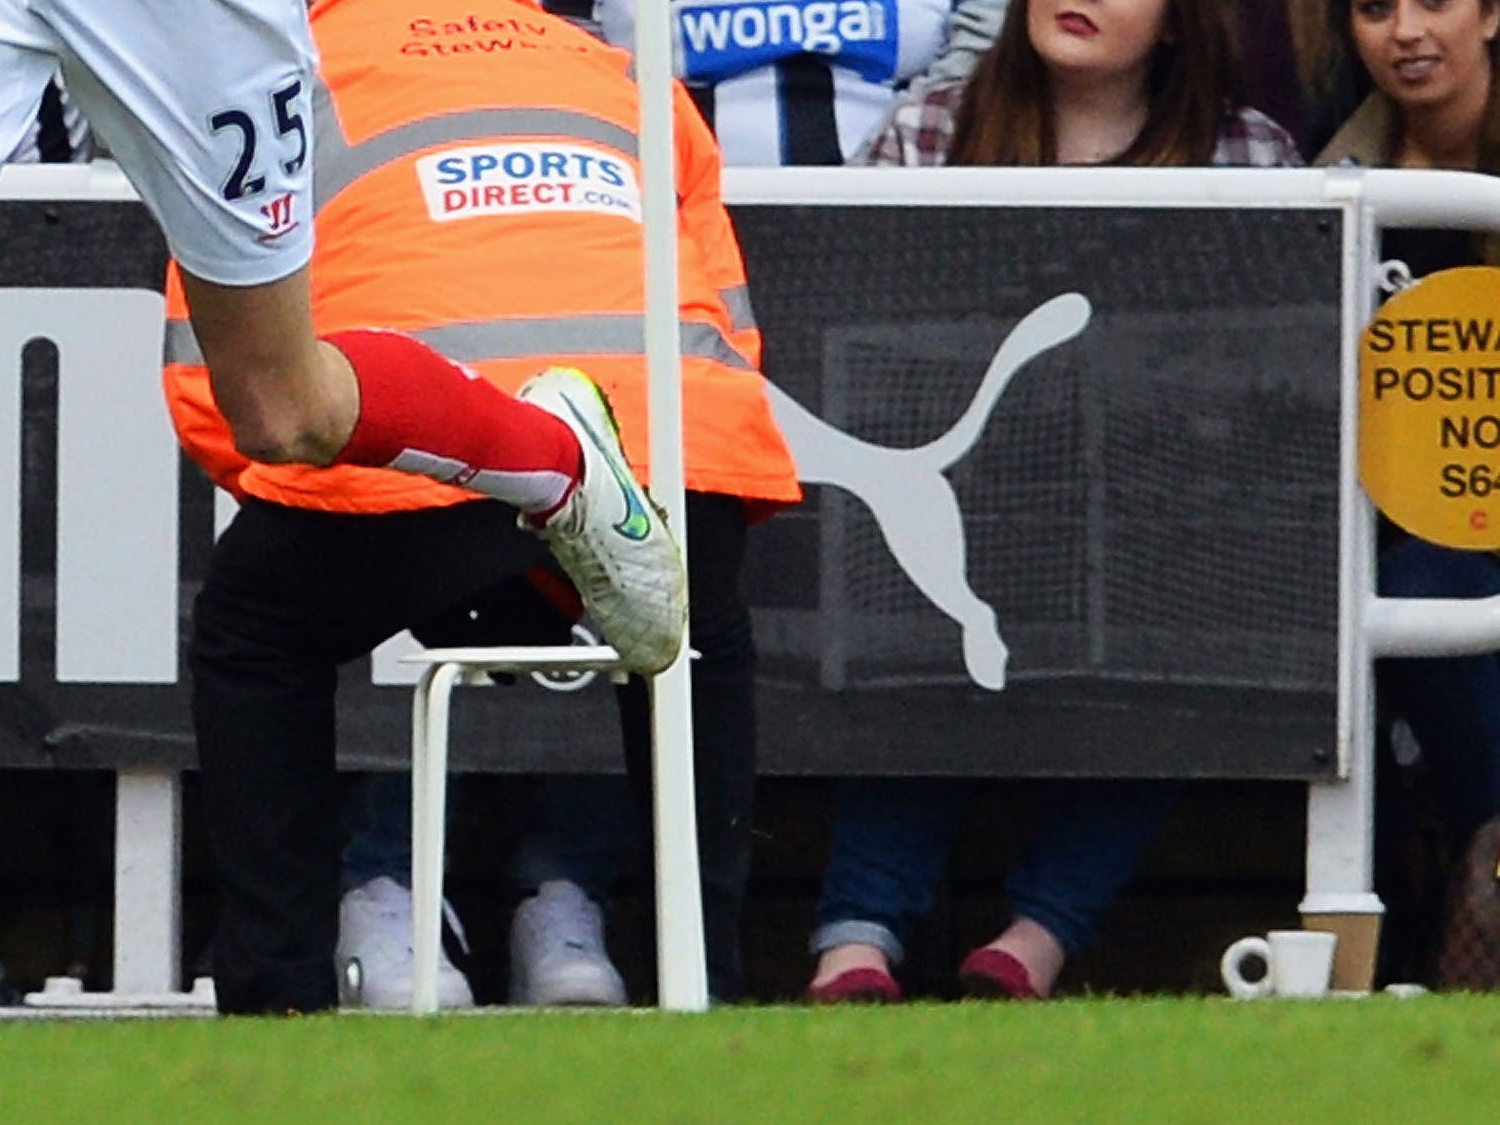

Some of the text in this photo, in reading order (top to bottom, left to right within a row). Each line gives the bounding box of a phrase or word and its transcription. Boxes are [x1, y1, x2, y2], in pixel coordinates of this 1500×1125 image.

[211, 80, 307, 201] 25
[437, 152, 624, 186] SPORTS
[1368, 319, 1500, 353] STEW
